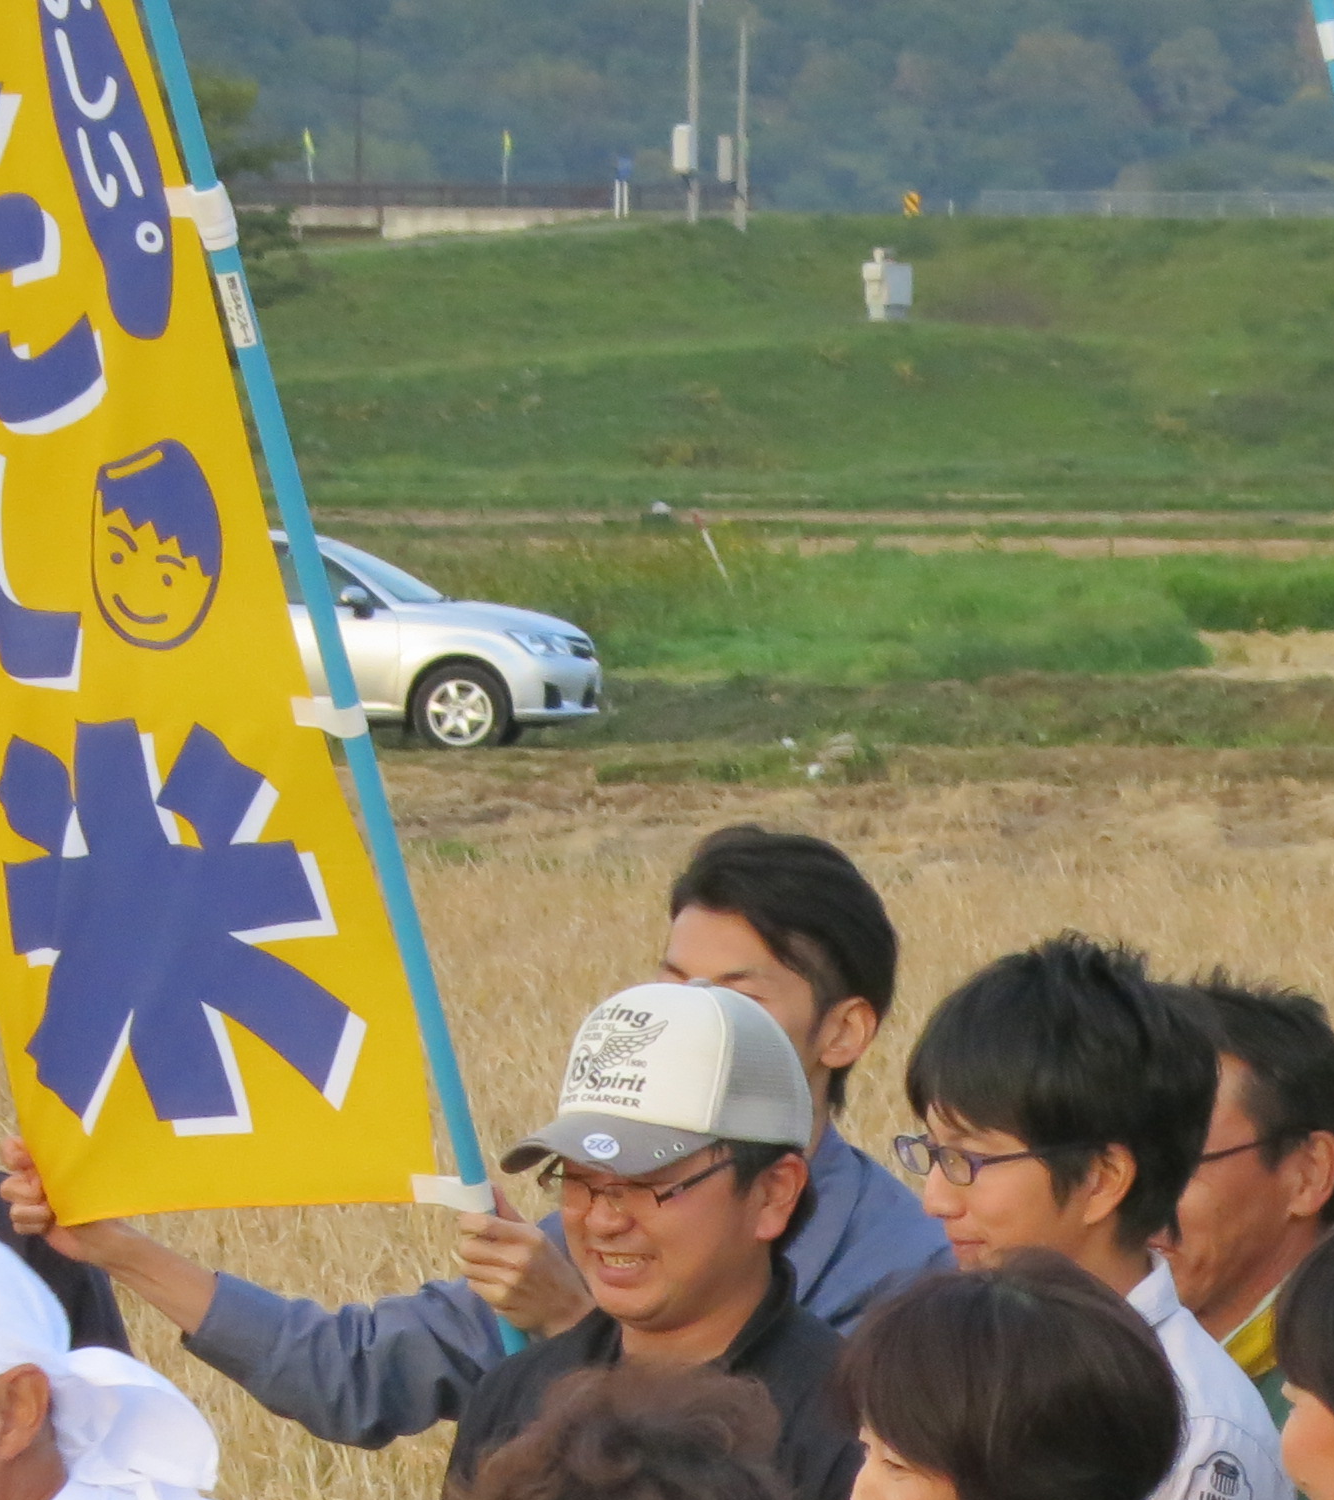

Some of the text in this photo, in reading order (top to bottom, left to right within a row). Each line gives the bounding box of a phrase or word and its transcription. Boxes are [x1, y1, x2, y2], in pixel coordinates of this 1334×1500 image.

[42, 0, 165, 254] しい。
[585, 1069, 647, 1093] Spirit
[580, 1093, 642, 1109] CHARGER
